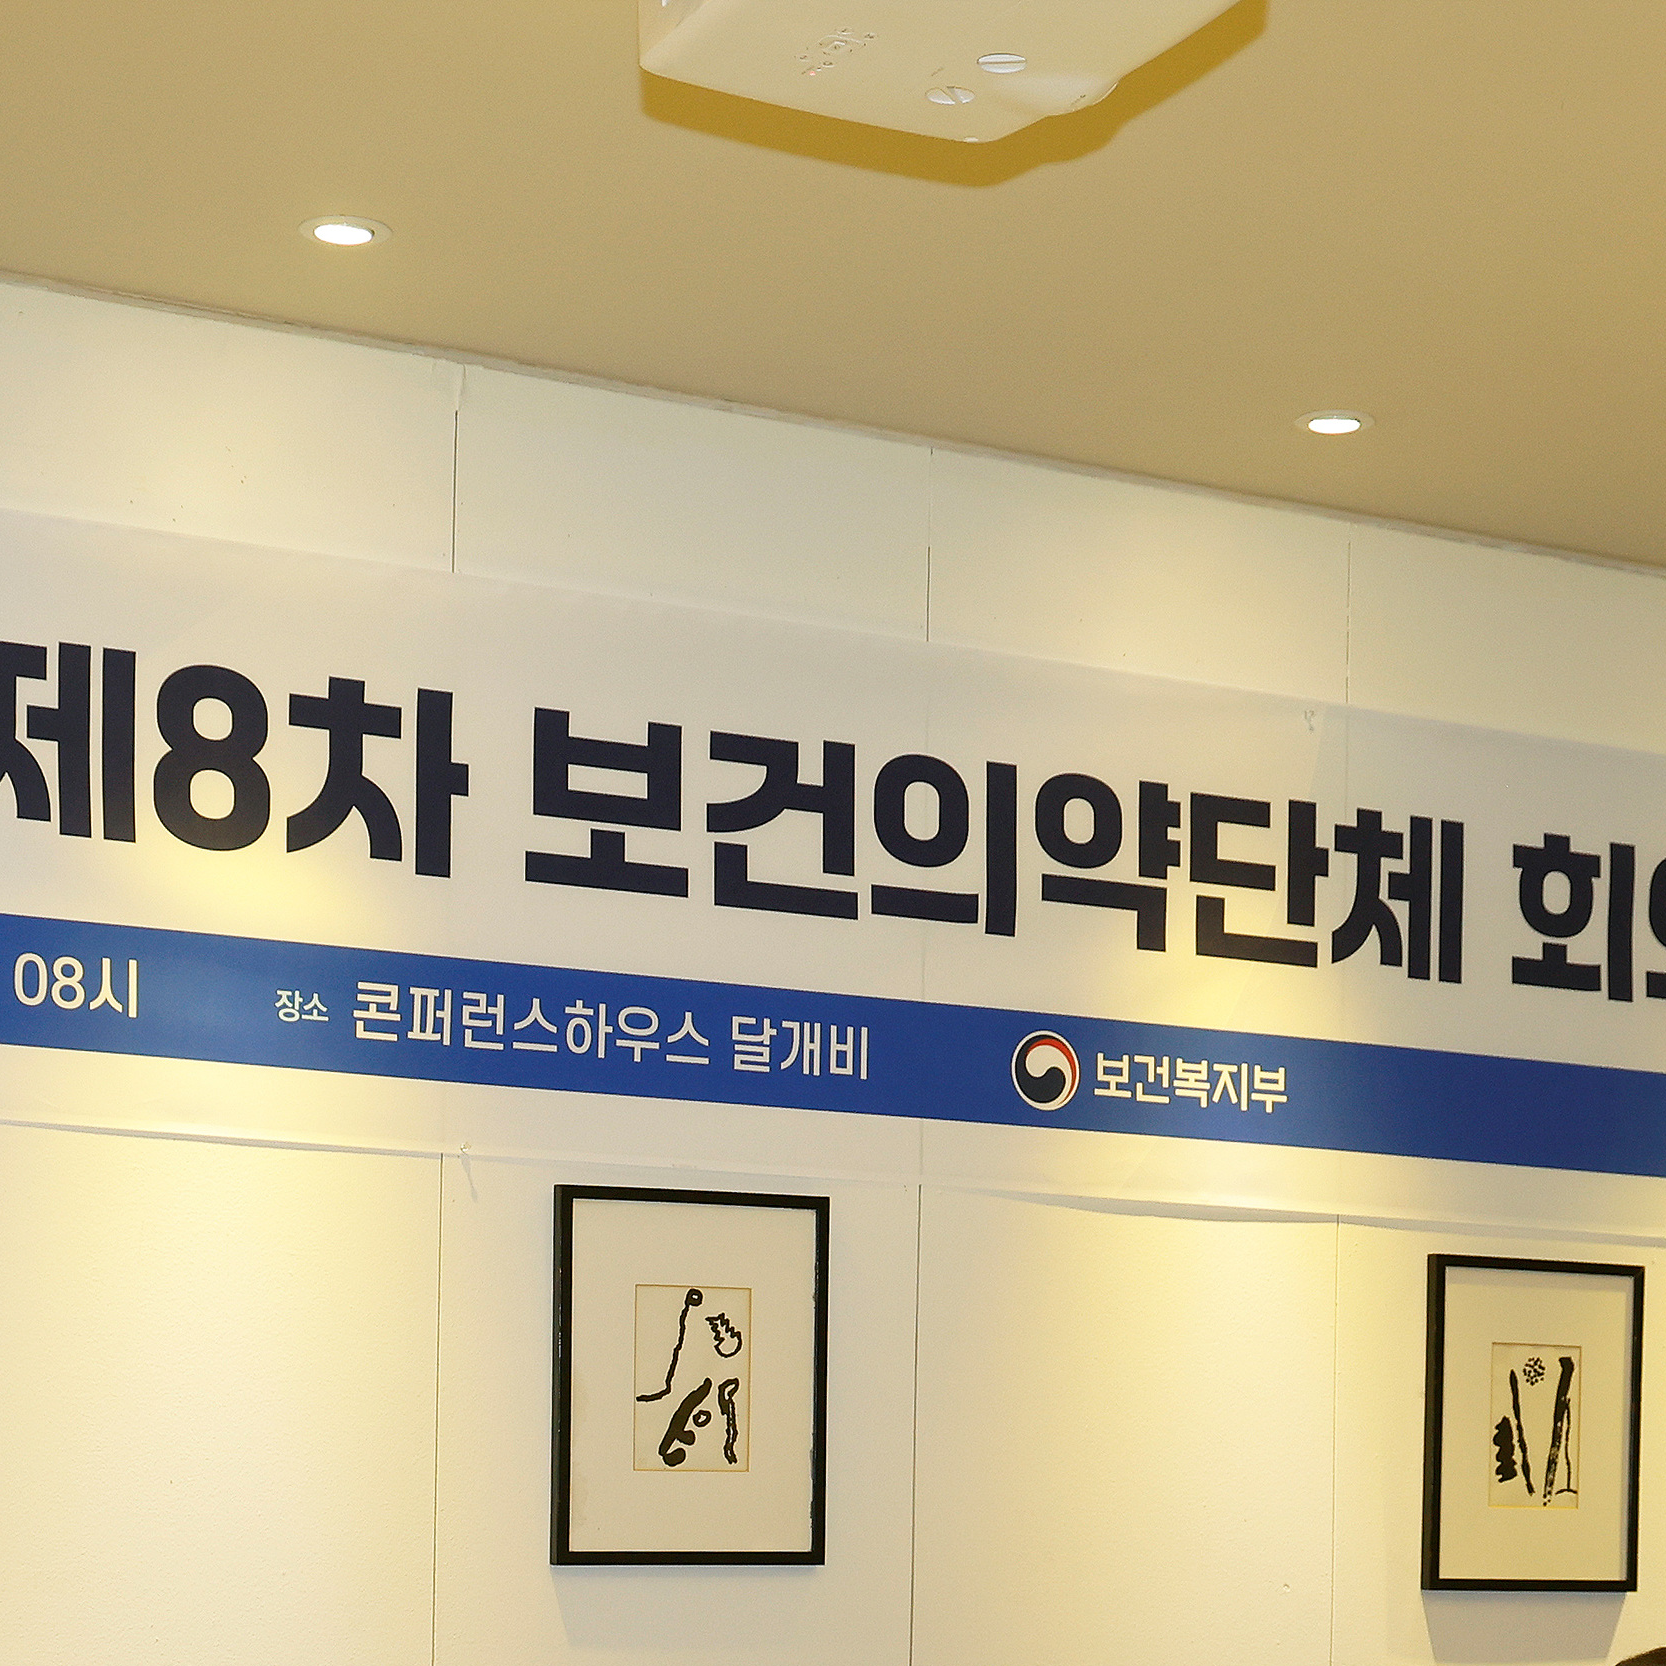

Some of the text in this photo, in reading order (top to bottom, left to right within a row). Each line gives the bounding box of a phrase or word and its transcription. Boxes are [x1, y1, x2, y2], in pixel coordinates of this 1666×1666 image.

[525, 709, 1465, 984] 보건의약단체
[14, 953, 139, 1020] 08시
[274, 981, 869, 1081] 장소 콘퍼런스하우스 달개비
[1093, 1053, 1290, 1115] 보건복지부
